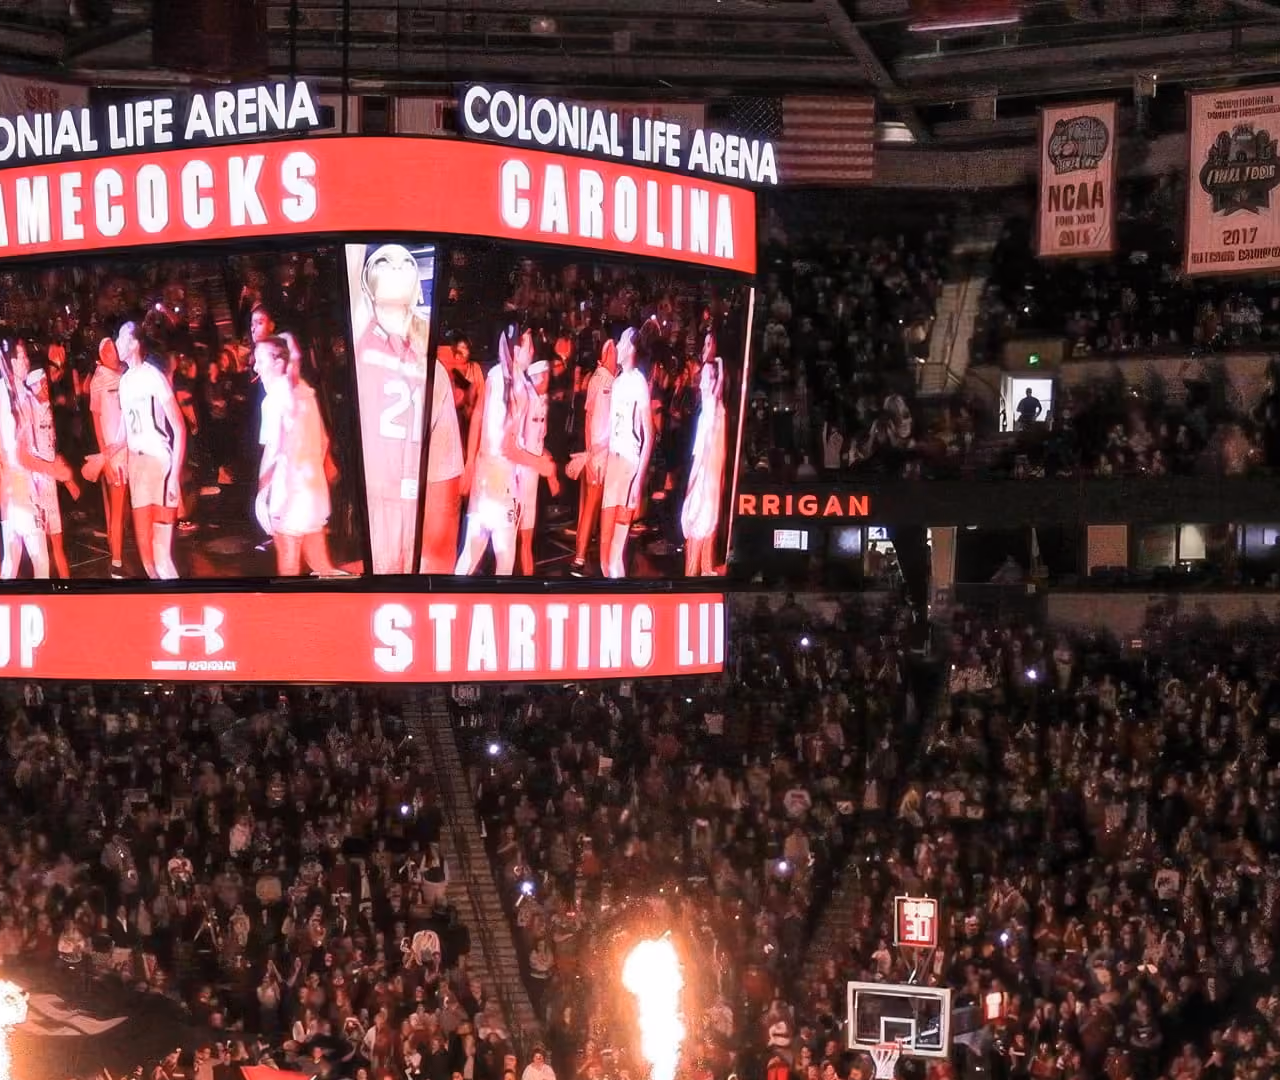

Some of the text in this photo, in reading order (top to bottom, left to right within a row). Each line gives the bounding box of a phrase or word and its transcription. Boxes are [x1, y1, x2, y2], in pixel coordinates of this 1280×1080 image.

[109, 98, 173, 149] LIFE
[184, 81, 319, 140] ARENA
[460, 86, 623, 157] COLONIAL
[632, 116, 680, 168] LIFE
[688, 129, 777, 185] ARENA
[500, 159, 734, 259] CAROLINA
[1048, 180, 1104, 212] NCAA
[372, 603, 654, 673] STARTING
